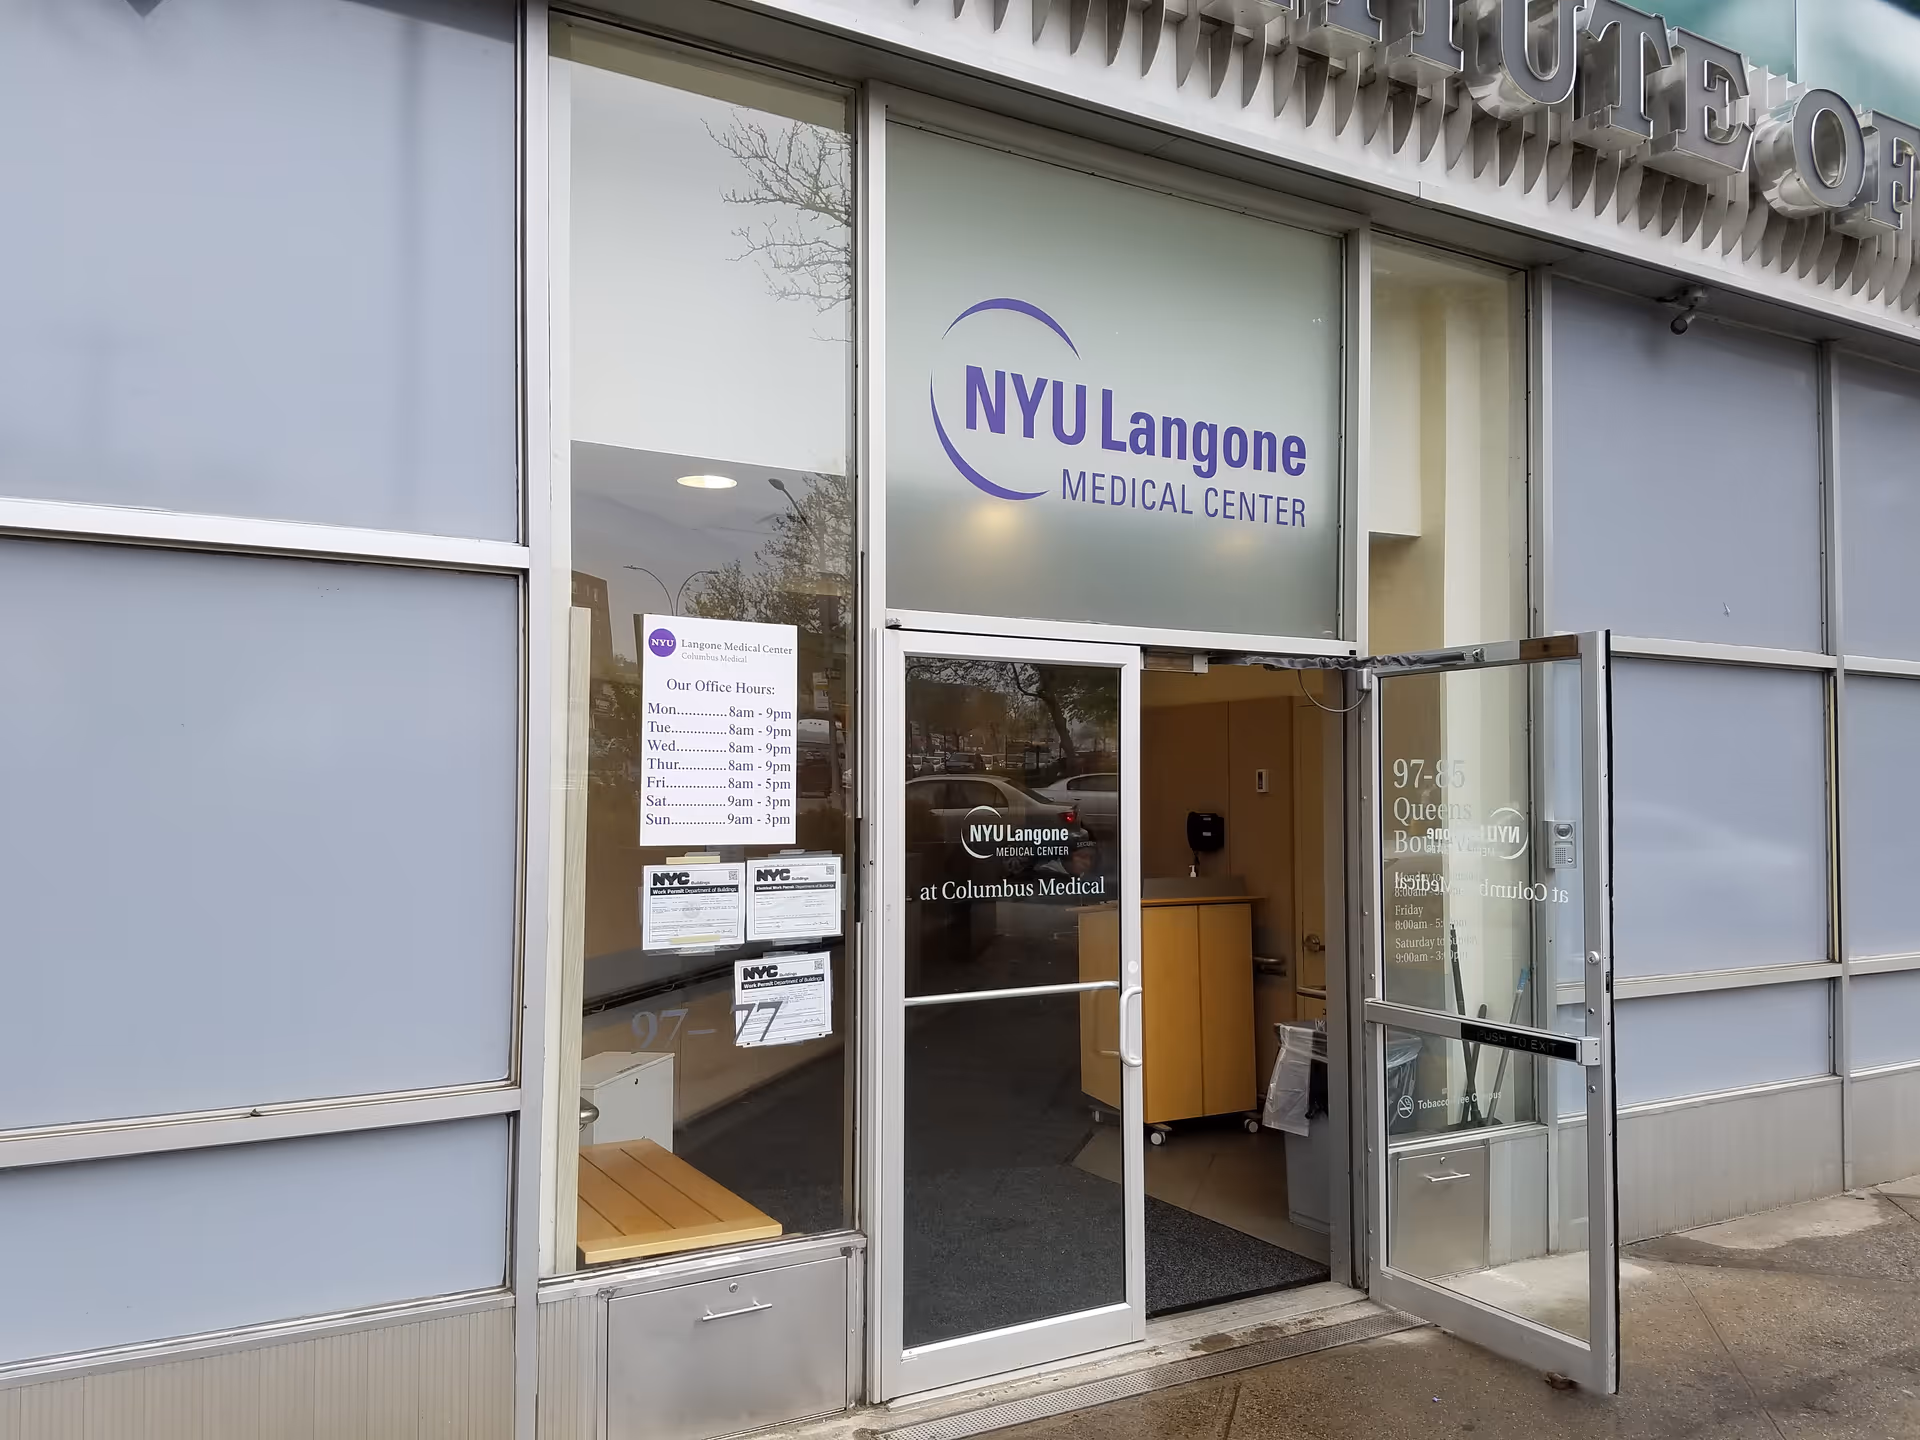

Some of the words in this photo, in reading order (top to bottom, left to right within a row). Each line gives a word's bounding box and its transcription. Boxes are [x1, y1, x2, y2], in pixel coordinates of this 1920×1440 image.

[965, 364, 1087, 446] NYU
[1101, 388, 1307, 479] Langone
[1062, 468, 1193, 515] MEDICAL
[1204, 487, 1306, 528] CENTER
[651, 638, 674, 647] NYU
[681, 639, 722, 651] Langone
[724, 642, 761, 653] Medical
[762, 645, 793, 654] Center
[681, 652, 719, 661] Columbus
[720, 654, 748, 663] Medical
[667, 678, 691, 691] Our
[695, 679, 732, 693] Office
[735, 682, 775, 695] Hours:
[766, 707, 792, 721] 9pm
[766, 725, 791, 739] 9pm
[765, 742, 791, 757] 9pm
[765, 760, 791, 774] 9pm
[1393, 758, 1465, 788] 97-85
[765, 778, 791, 792] 5pm
[765, 795, 791, 810] 3pm
[1393, 796, 1472, 827] Queens
[765, 813, 790, 828] 3pm
[970, 824, 1004, 842] NYU
[1007, 825, 1069, 845] Langone
[996, 846, 1034, 857] MEDICAL
[1037, 846, 1069, 856] CENTER
[652, 872, 690, 886] NYC
[756, 868, 791, 882] NYC
[920, 884, 937, 901] at
[942, 879, 1034, 900] Columbus
[1038, 876, 1105, 896] Medical
[1395, 904, 1423, 917] Friday
[1395, 919, 1427, 930] 8:00am
[1395, 936, 1435, 949] Saturday
[1437, 938, 1445, 946] to
[1395, 952, 1428, 963] 9:00am
[743, 965, 778, 980] NYC
[1477, 1030, 1507, 1043] PUSH
[1512, 1036, 1527, 1048] TO
[1531, 1040, 1557, 1053] EXIT
[1472, 1091, 1502, 1102] Cpus
